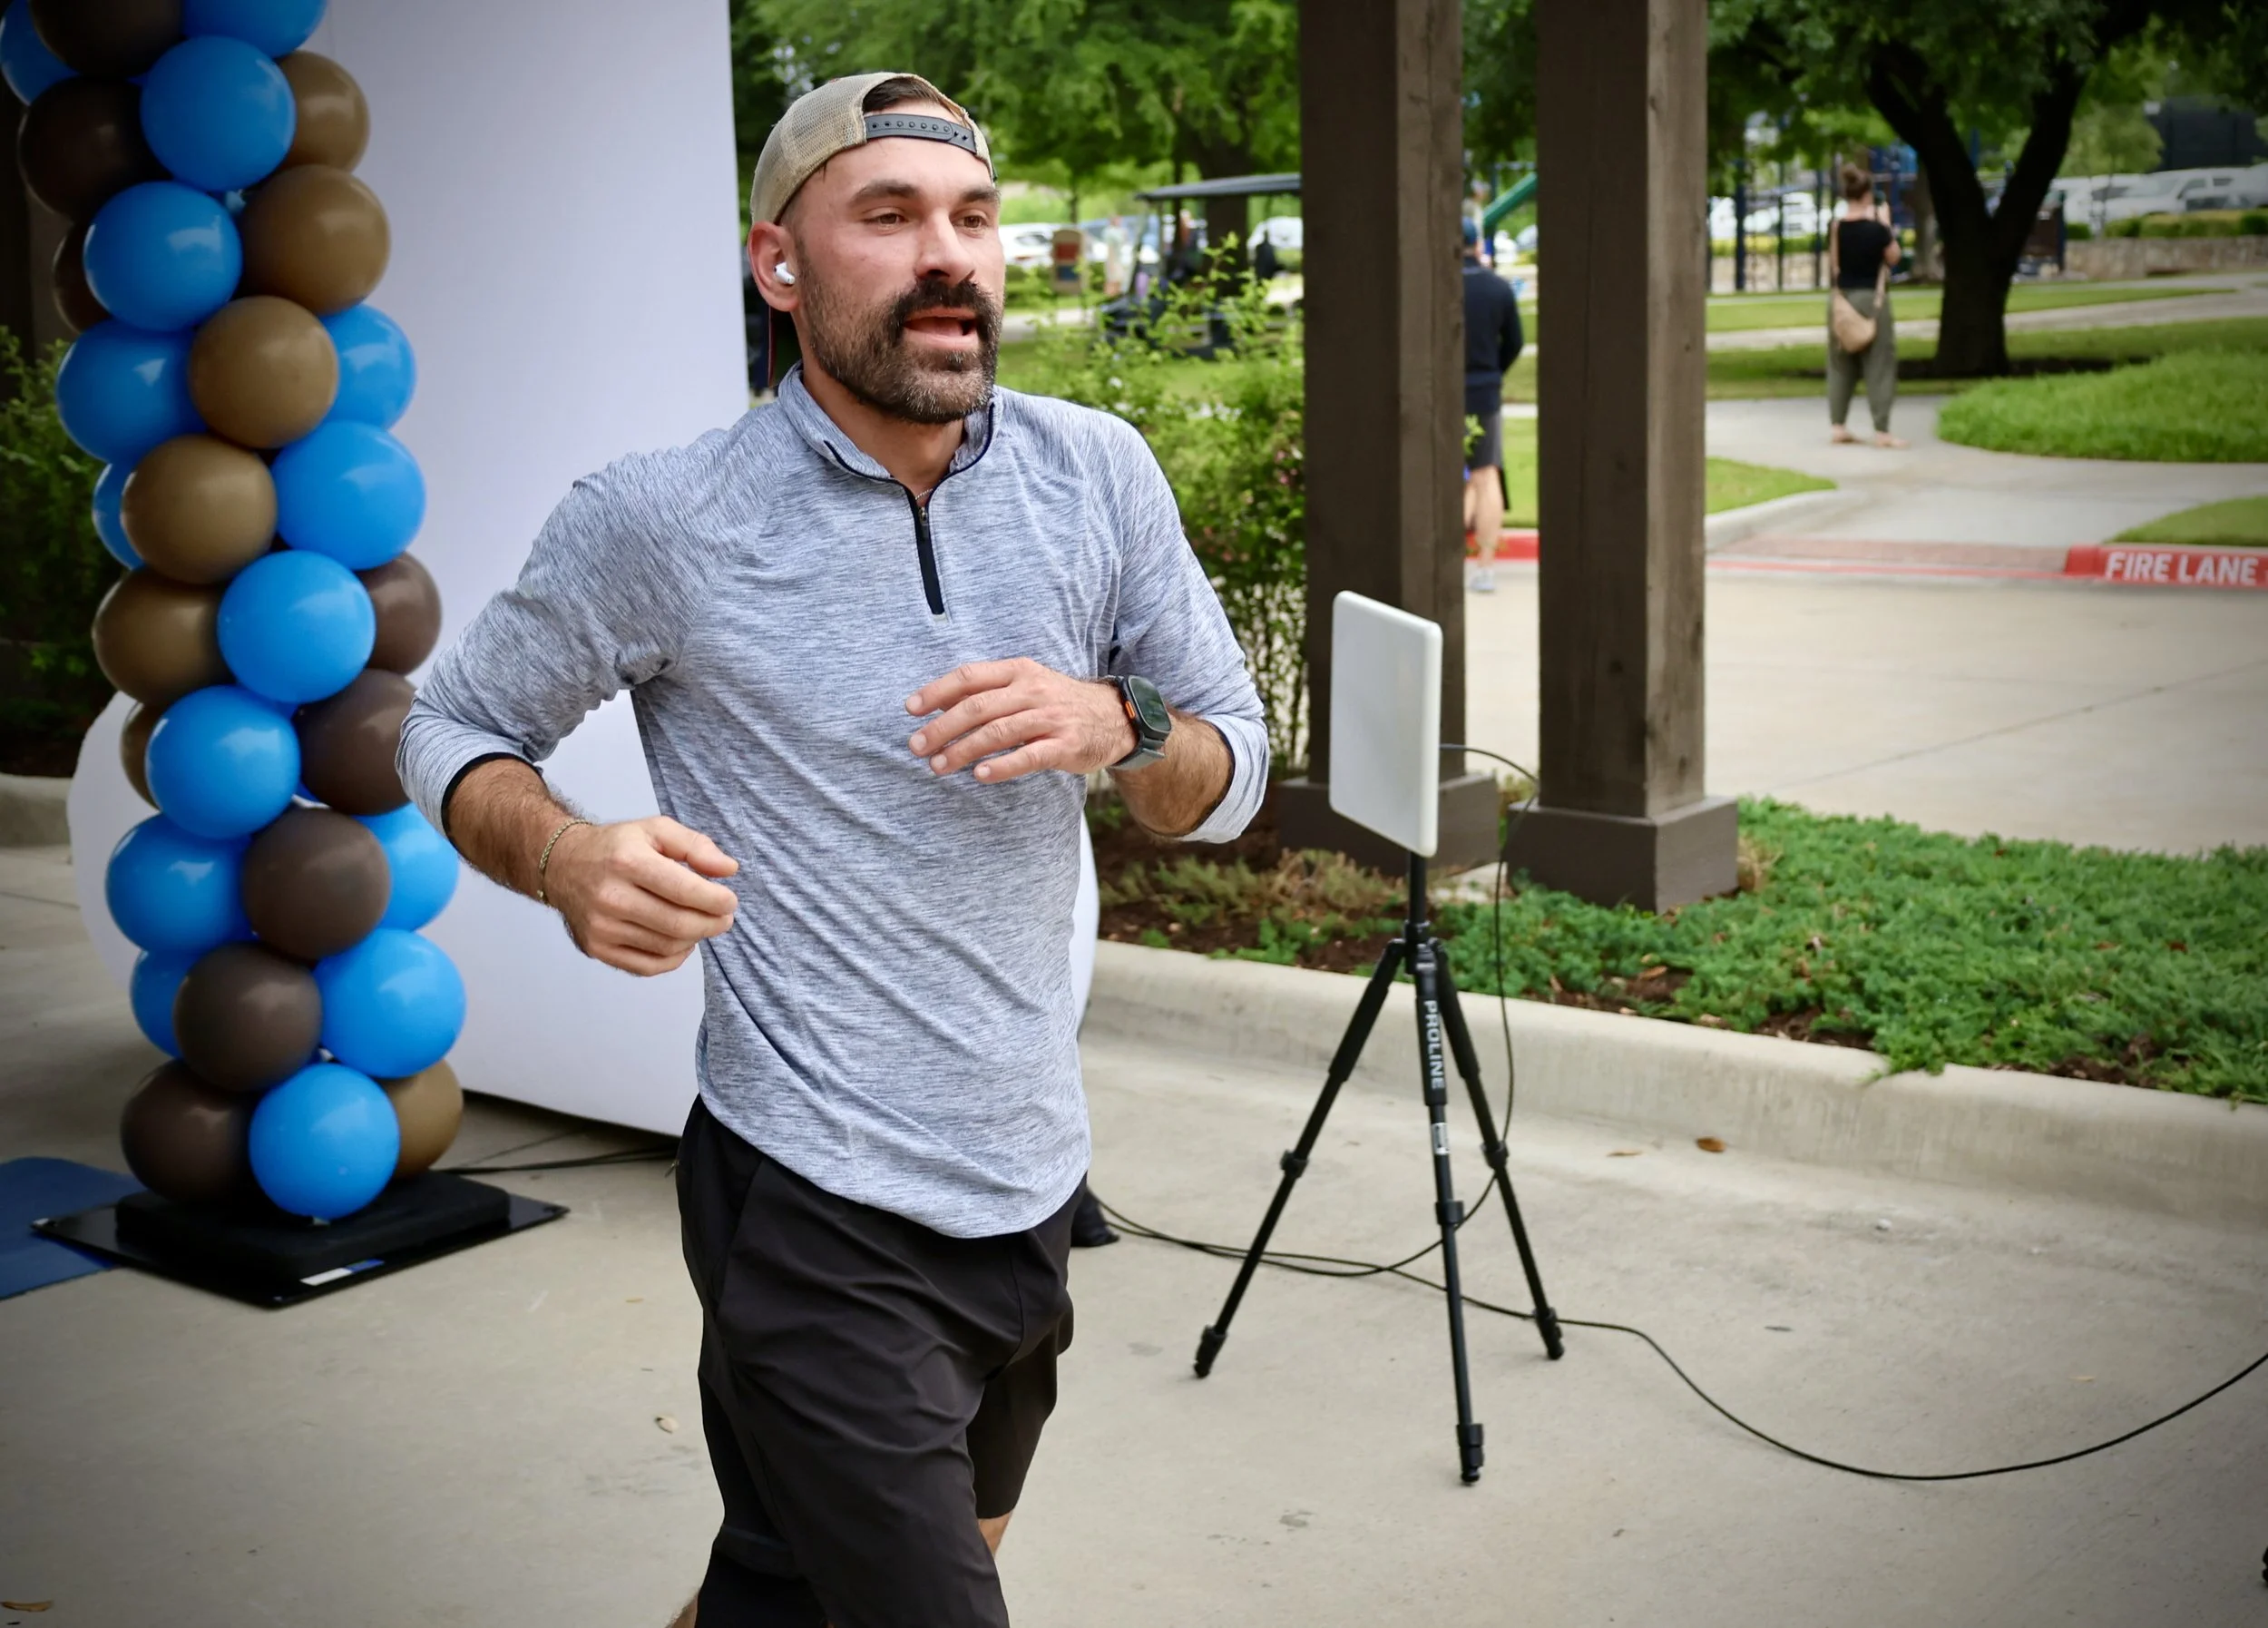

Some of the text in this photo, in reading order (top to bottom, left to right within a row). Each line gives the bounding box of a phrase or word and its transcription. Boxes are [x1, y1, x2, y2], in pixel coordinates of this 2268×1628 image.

[2106, 551, 2259, 585] FIRE LANE
[1424, 1000, 1445, 1089] PROLINE
